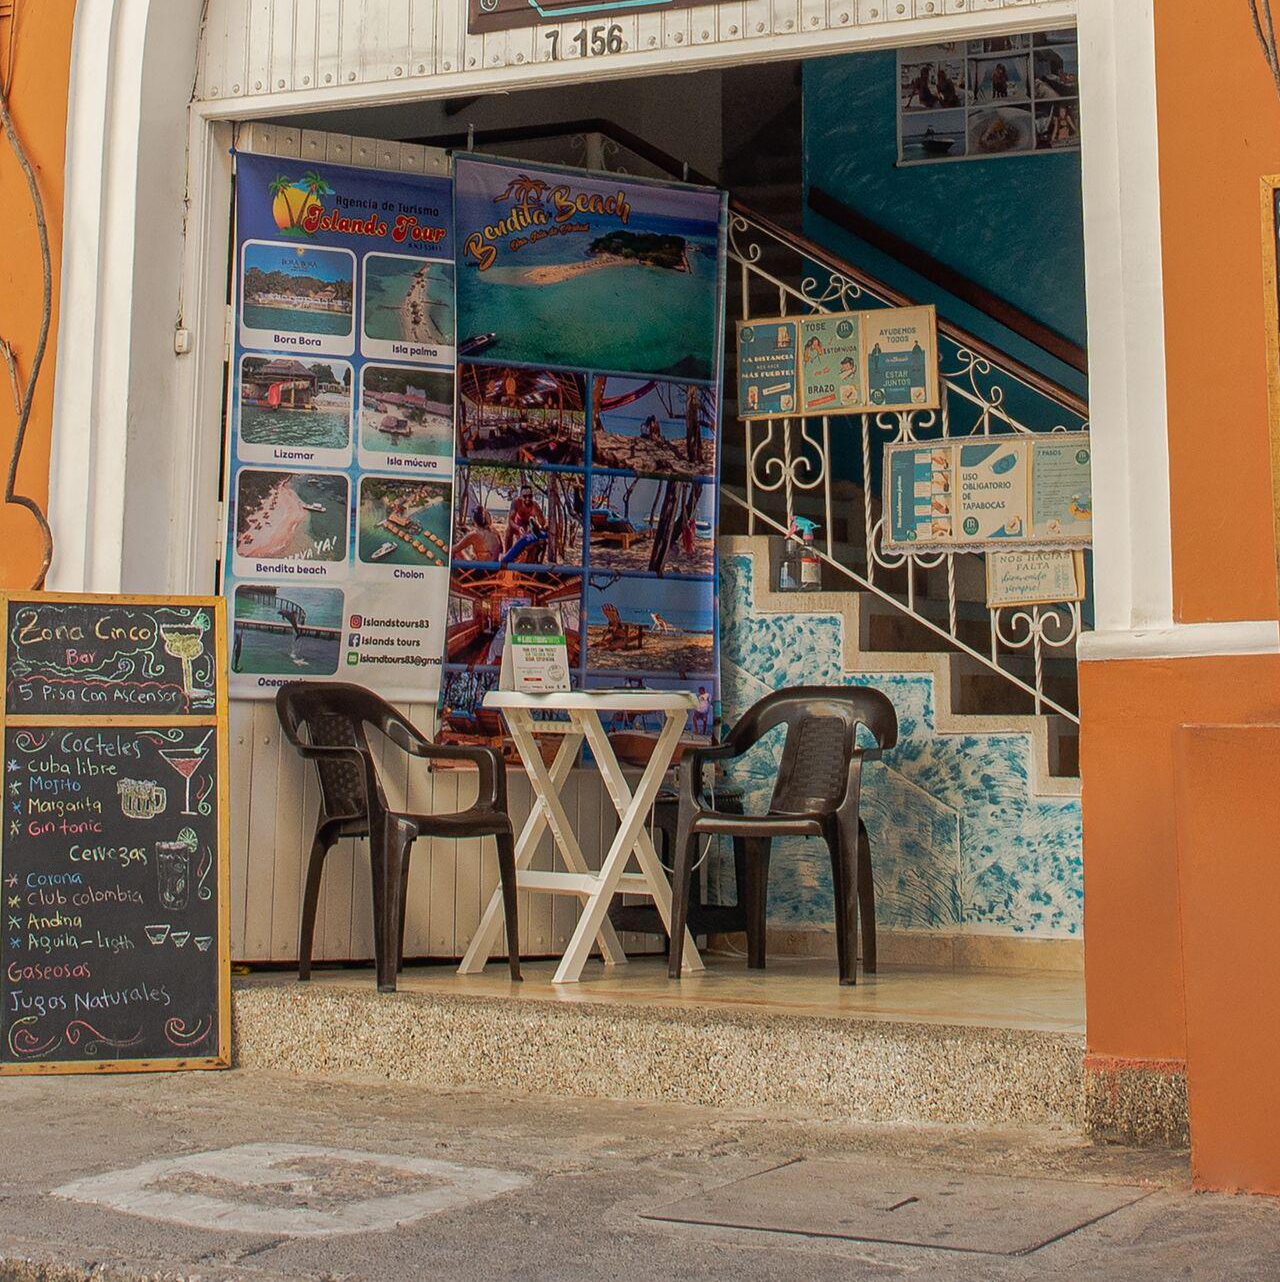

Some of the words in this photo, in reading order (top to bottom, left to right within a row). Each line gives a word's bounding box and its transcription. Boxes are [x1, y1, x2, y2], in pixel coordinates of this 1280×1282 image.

[573, 23, 624, 58] 156
[335, 195, 379, 211] Agencia
[381, 201, 395, 212] de
[398, 202, 440, 217] Turismo
[302, 203, 389, 238] Islands
[391, 214, 447, 244] Tour
[463, 203, 550, 271] Bendita
[546, 184, 632, 225] Beach
[805, 322, 826, 332] TOSE
[879, 327, 917, 336] AYUDEMOS
[273, 334, 297, 345] Bora
[298, 337, 322, 347] Bora
[886, 335, 910, 344] TODOS
[392, 344, 408, 355] Isla
[409, 345, 438, 357] palma
[885, 369, 909, 379] ESTAR
[882, 378, 912, 387] JUNTOS
[807, 384, 835, 395] BRAZO
[273, 449, 315, 460] Lizamar
[386, 456, 403, 466] Isla
[962, 473, 978, 481] USO
[962, 481, 1012, 491] OBLIGATORIO
[962, 493, 971, 501] DE
[962, 501, 1006, 510] TAPABOCAS
[1000, 555, 1023, 564] NOS
[255, 563, 296, 575] Bendita
[297, 565, 327, 575] beach
[1016, 562, 1050, 571] FALTA
[393, 569, 425, 580] Cholon
[18, 610, 84, 645] Zona
[95, 615, 151, 642] Cinco
[363, 617, 430, 629] Islandstours83
[361, 636, 395, 647] Islands
[397, 637, 421, 647] tours
[65, 648, 96, 666] Bar
[19, 683, 34, 701] 5
[77, 756, 118, 776] libre
[29, 776, 82, 795] Mojito
[28, 797, 103, 817] Margarita
[28, 820, 56, 836] Gin
[60, 818, 103, 836] tonic
[69, 844, 148, 867] Cervezas
[26, 871, 83, 888] Corona
[72, 884, 144, 906] colombia
[27, 910, 83, 930] Andina
[7, 961, 91, 982] Gaseosas
[10, 990, 68, 1016] Jugos
[74, 982, 170, 1012] Naturales
